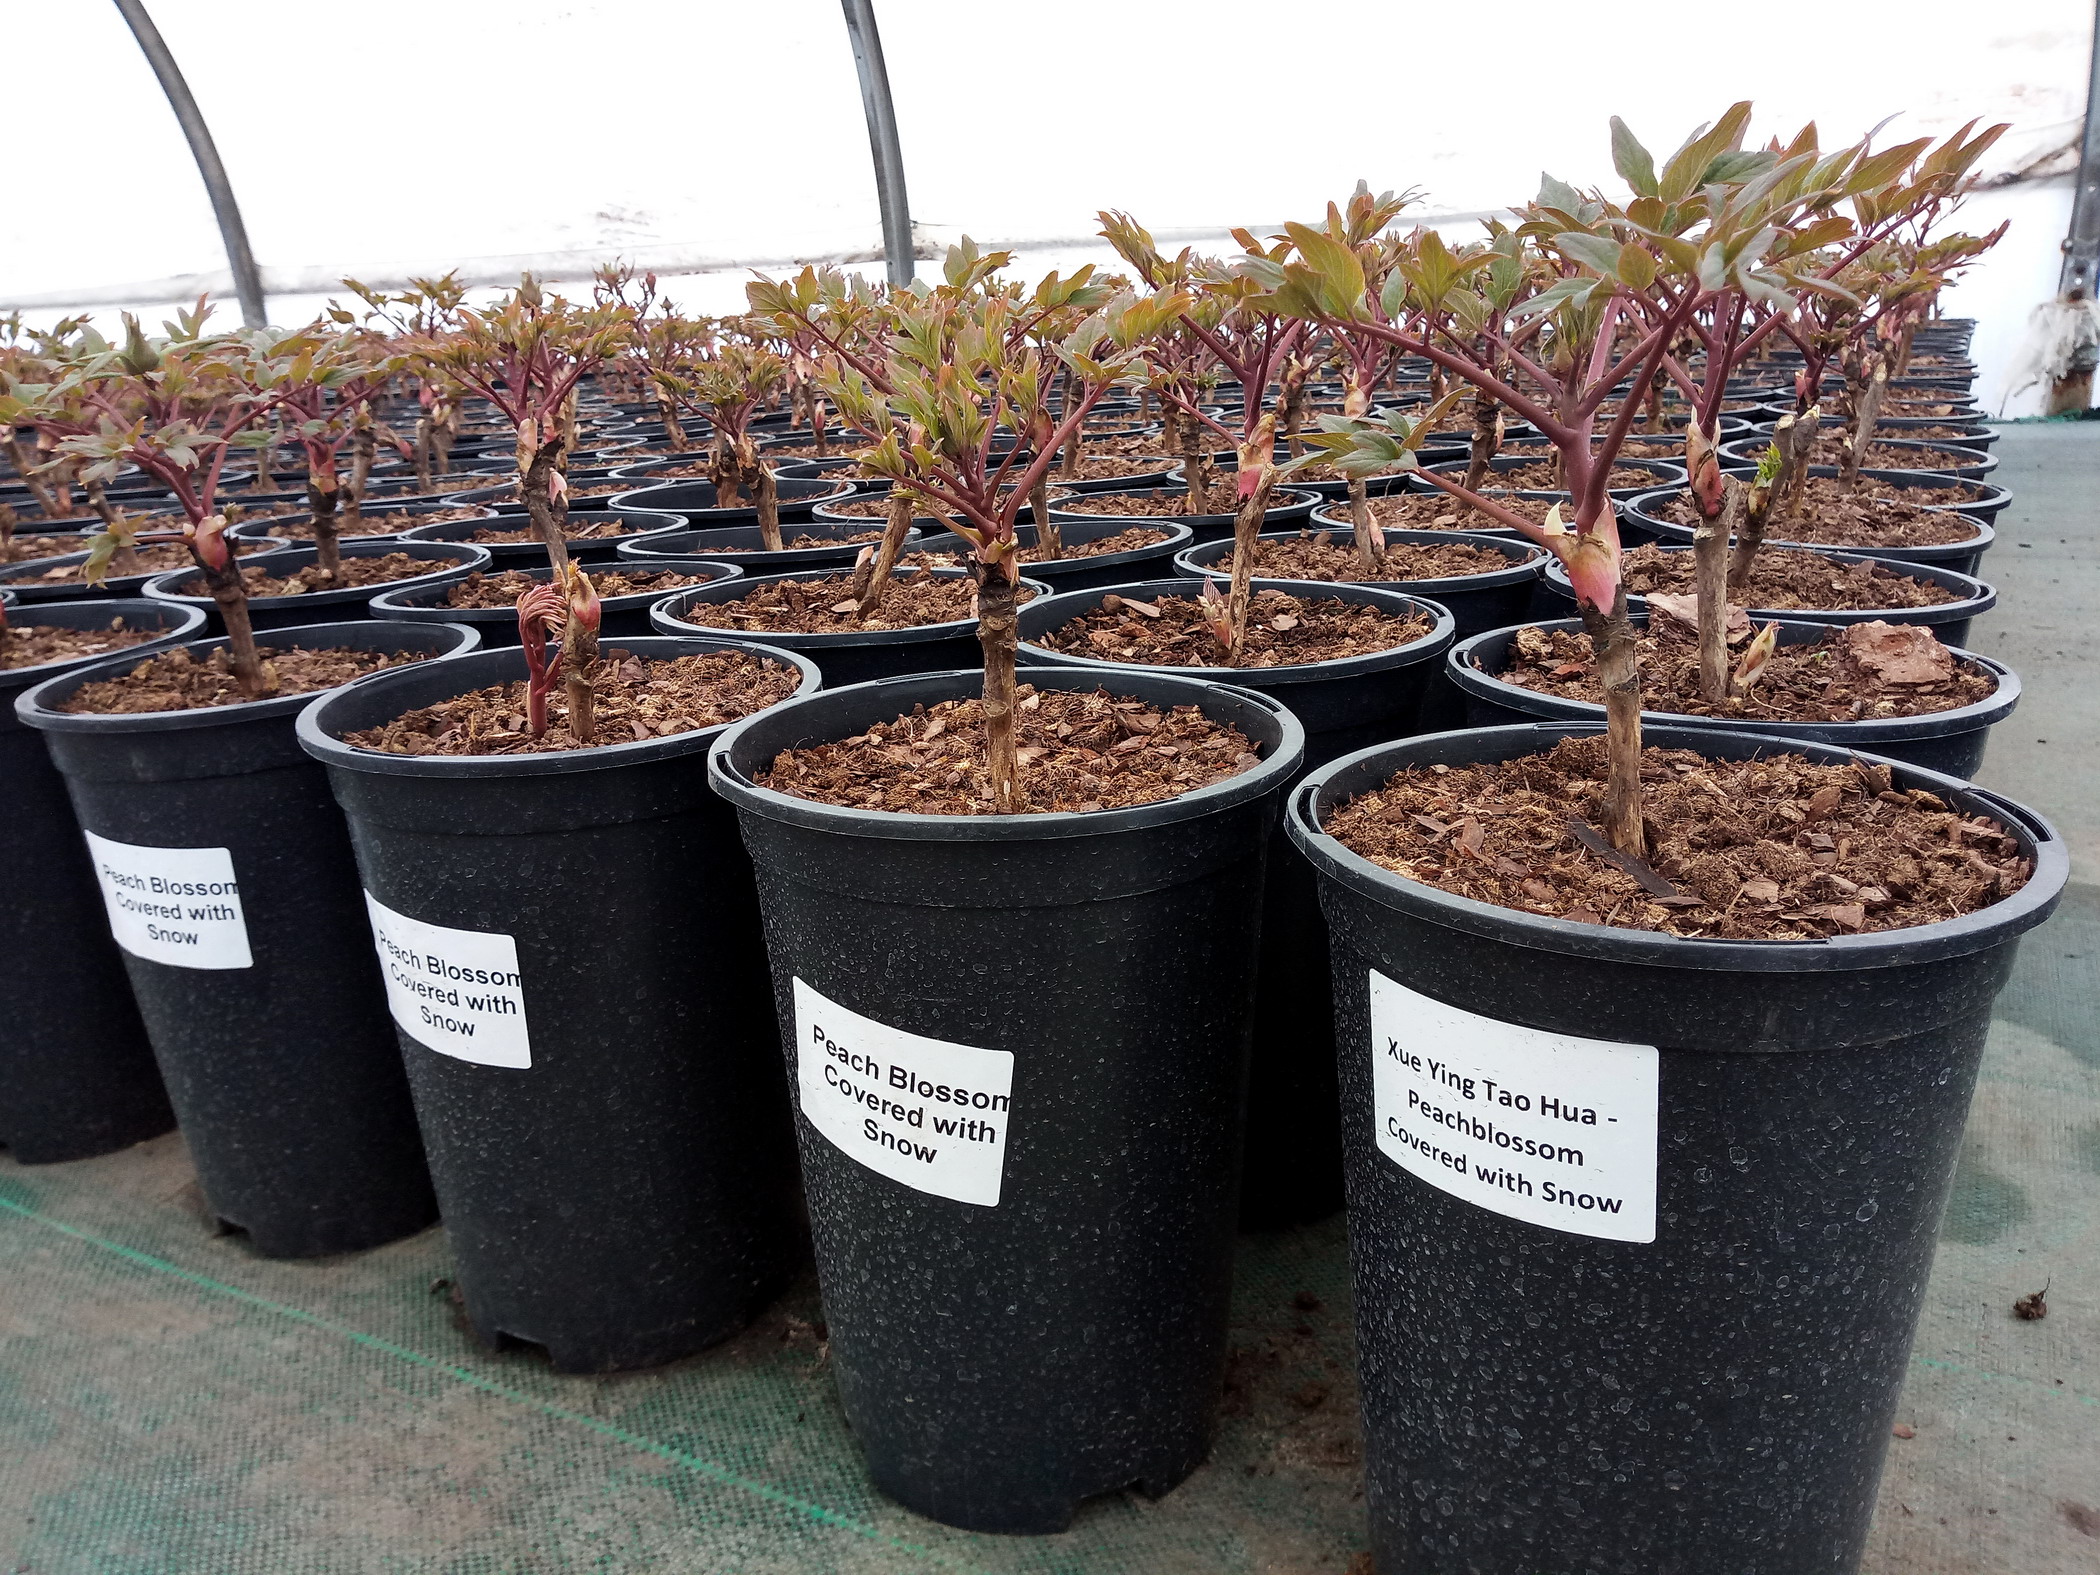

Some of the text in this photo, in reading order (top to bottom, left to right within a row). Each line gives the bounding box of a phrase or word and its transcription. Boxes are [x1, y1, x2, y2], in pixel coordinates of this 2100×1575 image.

[102, 864, 239, 896] Peach Blossom
[115, 892, 236, 920] Covered with
[147, 924, 199, 945] Snow
[378, 929, 521, 987] Peach Blossom
[390, 963, 517, 1015] Covered with
[420, 1005, 475, 1037] Snow
[813, 1024, 1012, 1113] Peach Blossom
[1387, 1036, 1422, 1073] Xue
[1427, 1057, 1476, 1100] Ying
[1482, 1079, 1531, 1112] Tao
[1540, 1095, 1598, 1126] Hua
[824, 1064, 996, 1144] Covered with
[1408, 1088, 1584, 1167] Peachblossom
[863, 1118, 938, 1164] Snow
[1387, 1116, 1623, 1214] Covered with Snow
